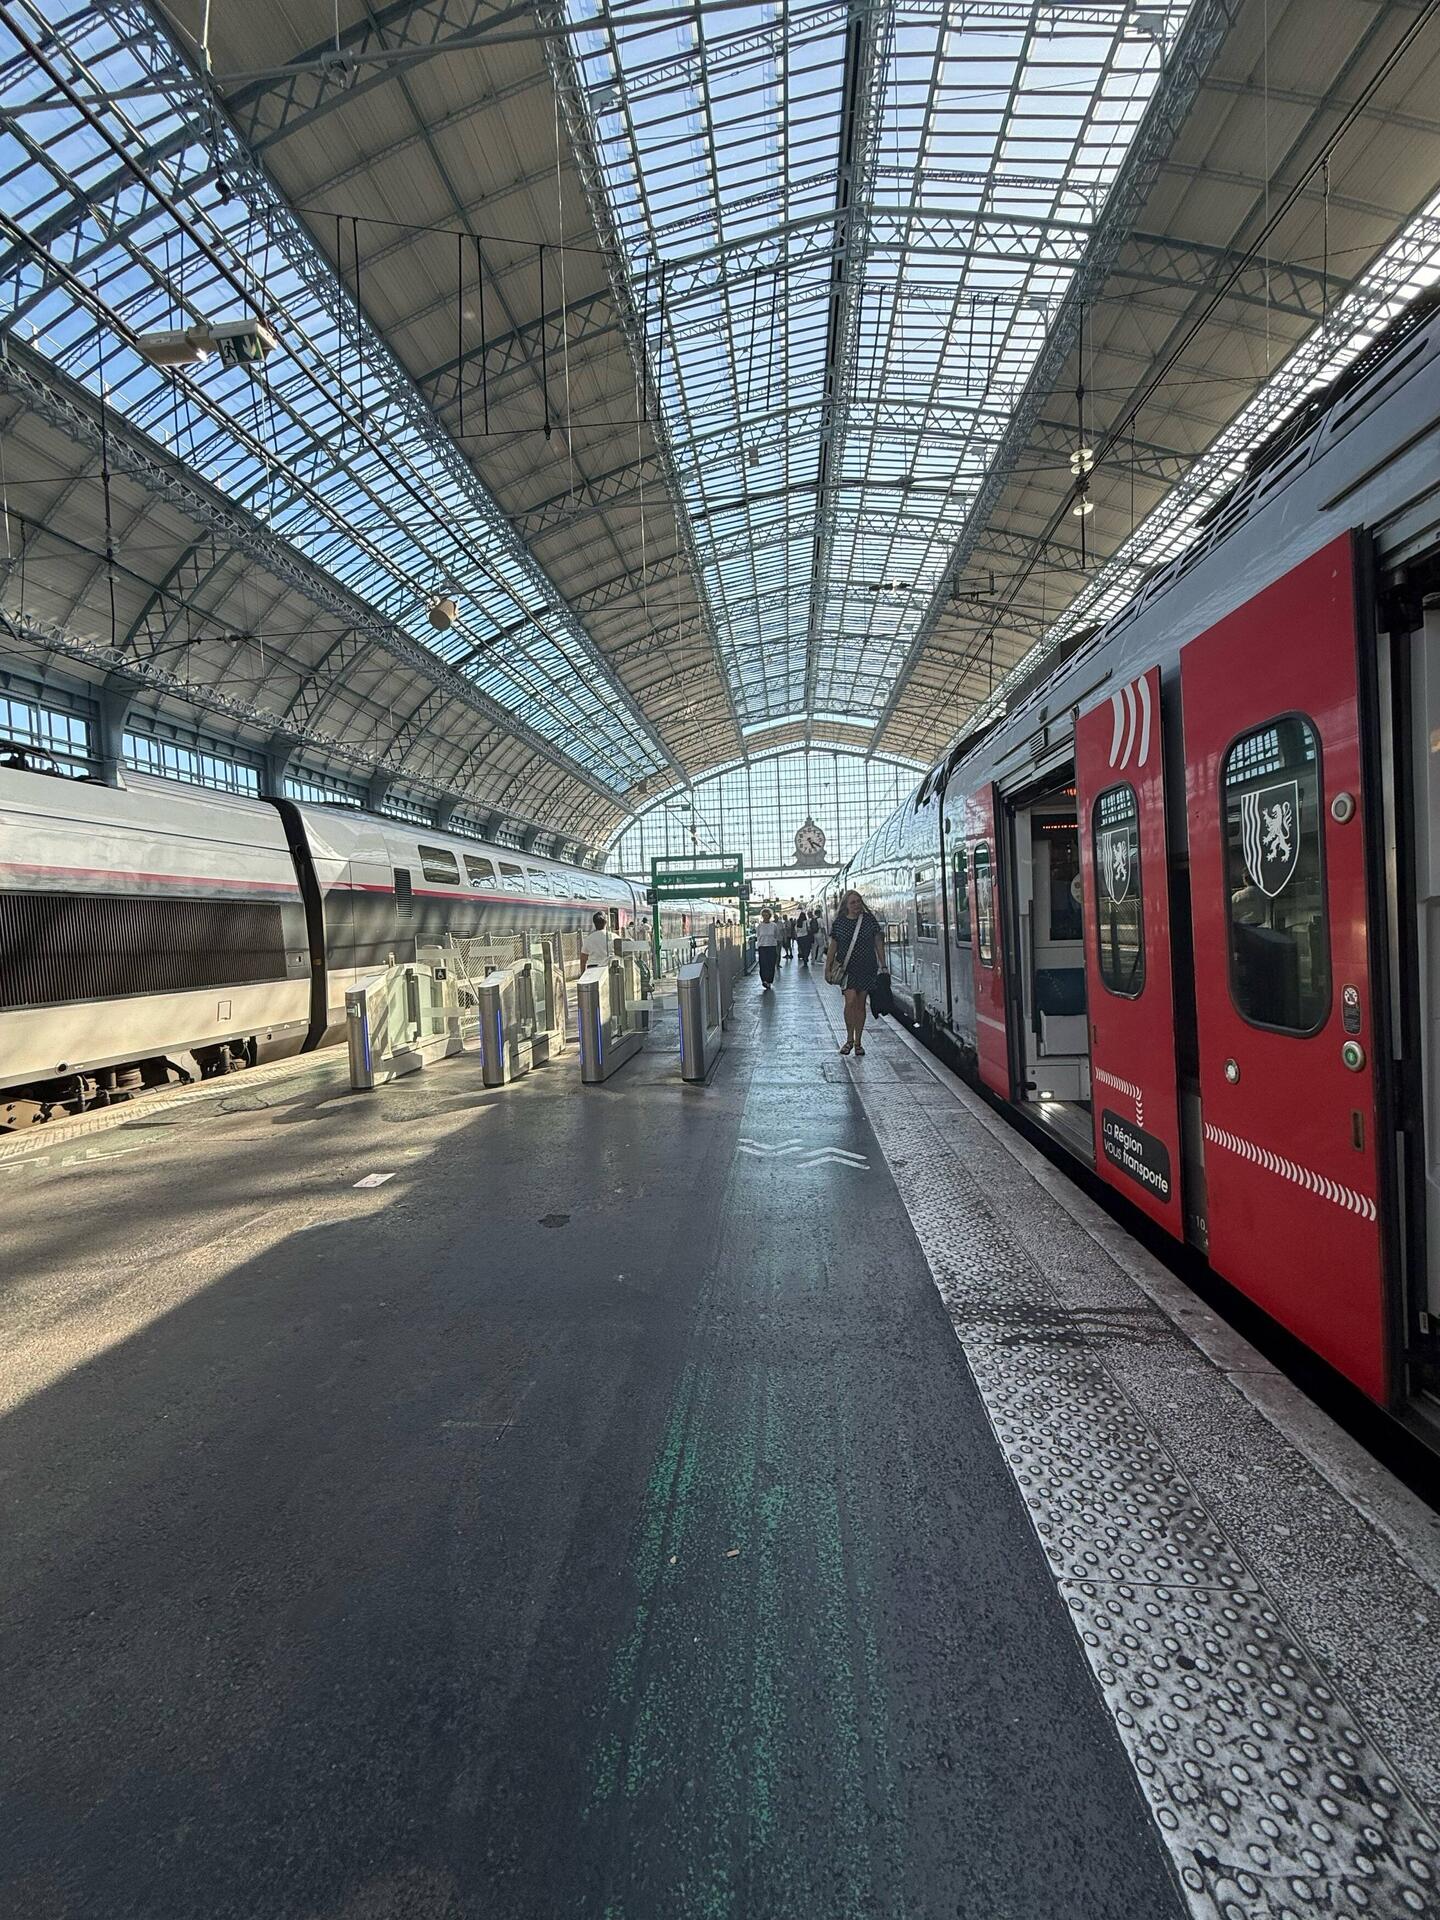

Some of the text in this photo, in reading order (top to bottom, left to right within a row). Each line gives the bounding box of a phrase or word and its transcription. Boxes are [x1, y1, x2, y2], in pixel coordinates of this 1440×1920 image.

[1103, 1117, 1143, 1155] La Région
[1104, 1140, 1168, 1193] vous transporte
